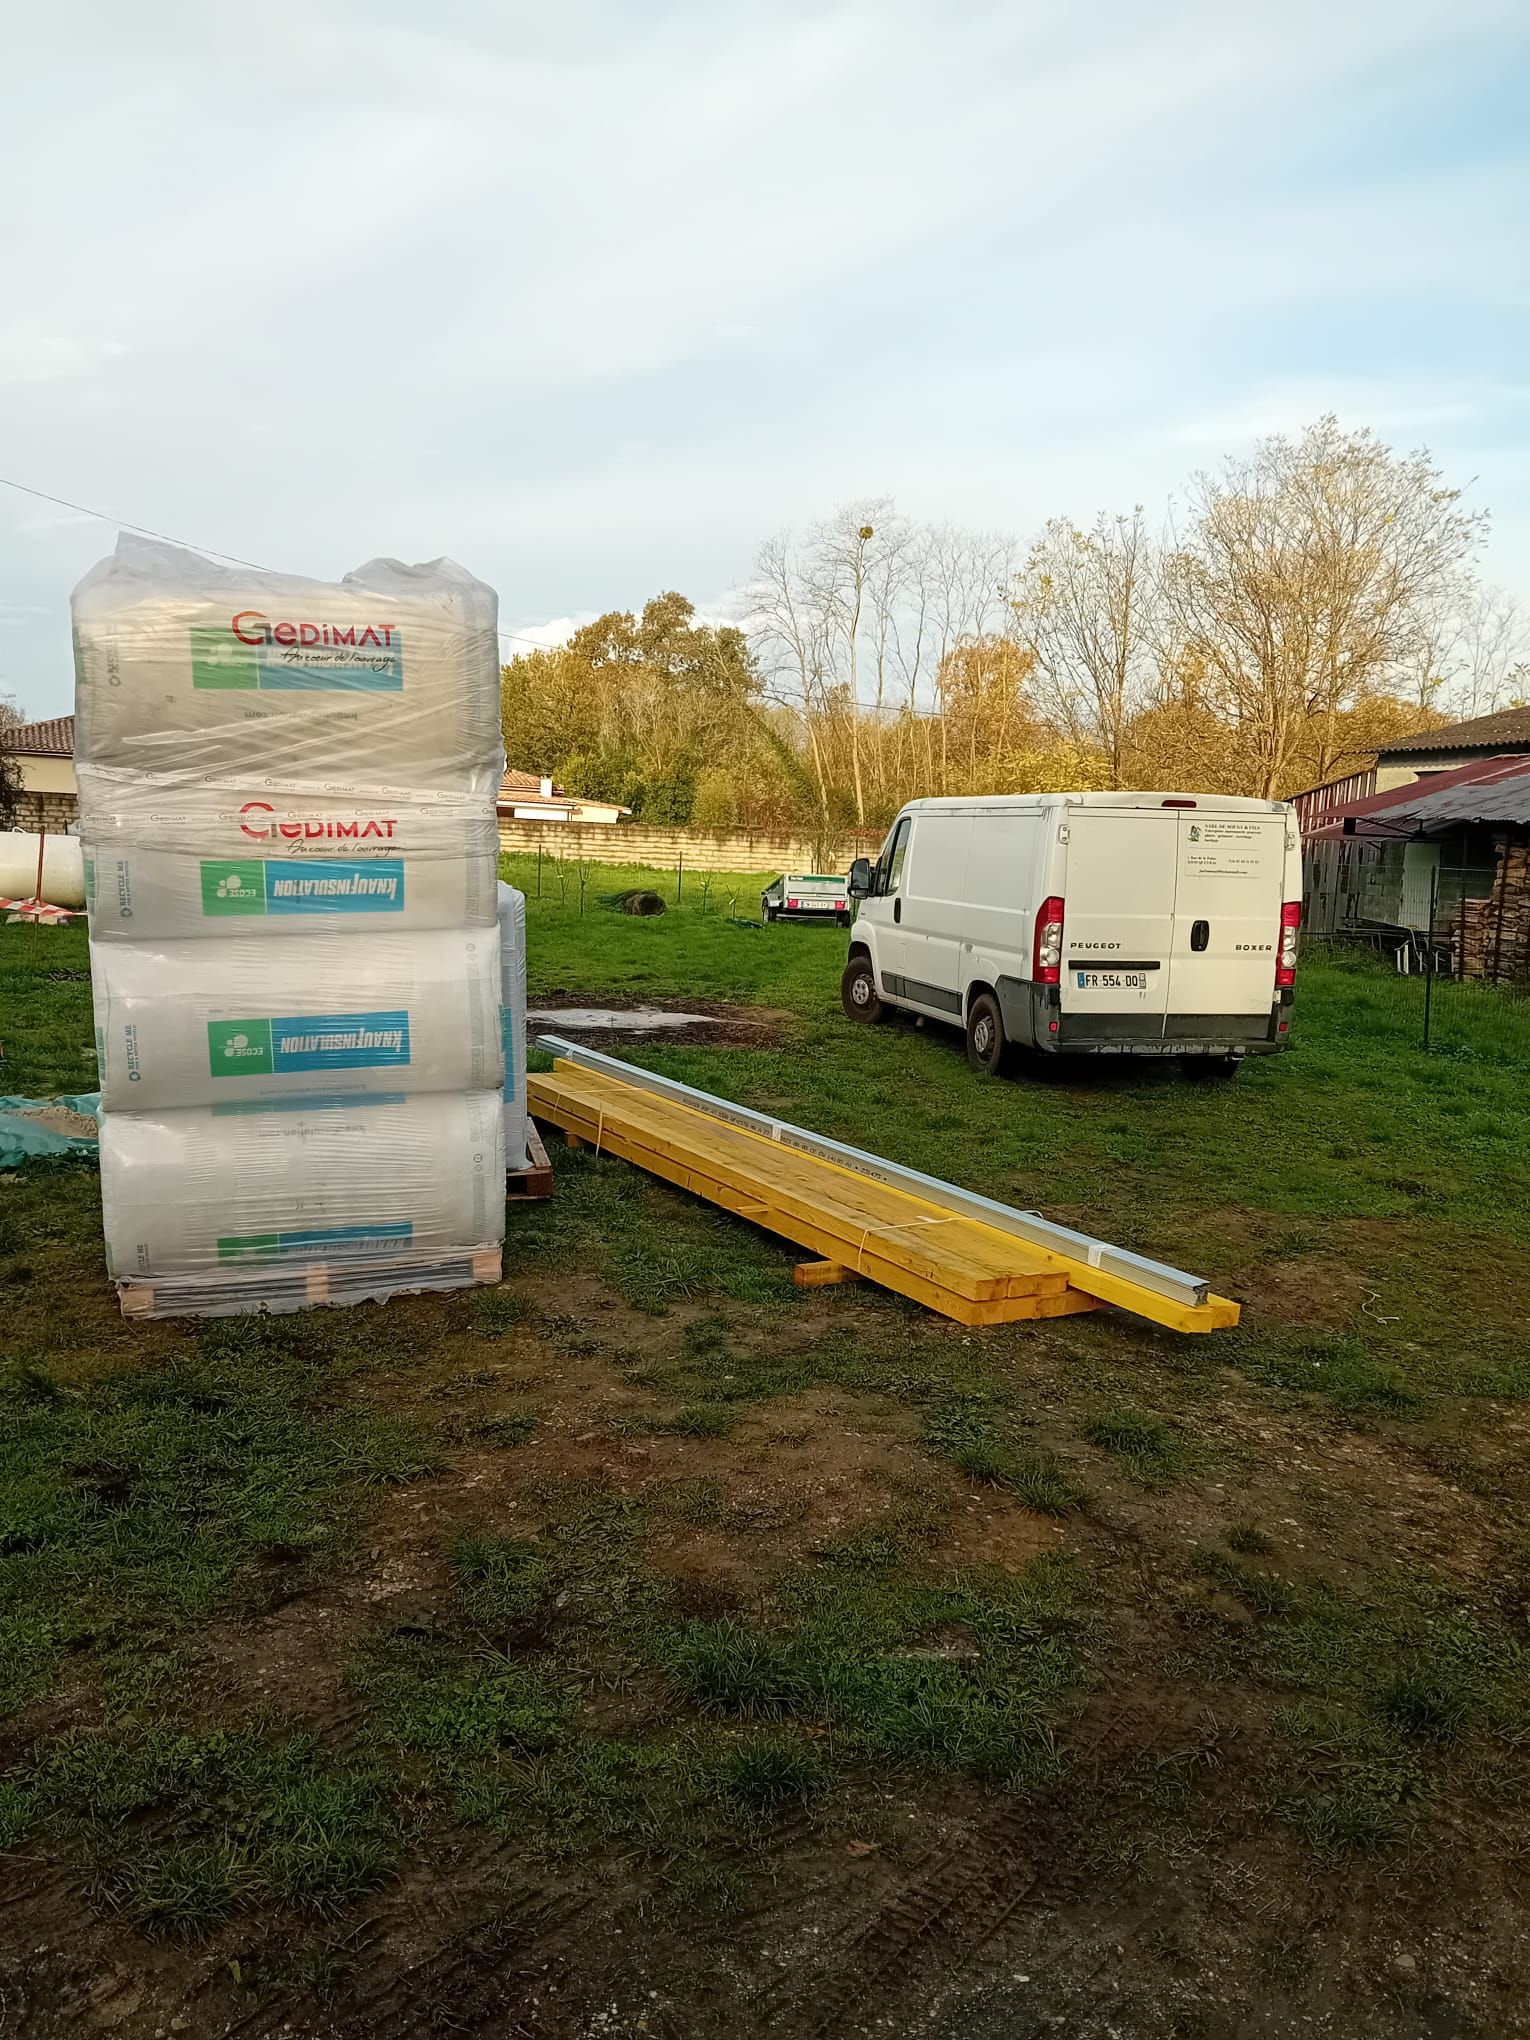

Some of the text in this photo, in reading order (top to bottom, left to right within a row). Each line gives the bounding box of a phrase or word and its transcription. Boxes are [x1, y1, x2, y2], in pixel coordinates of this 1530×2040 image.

[334, 651, 347, 662] de
[337, 843, 349, 852] de
[117, 861, 126, 905] RECYCLE ME
[228, 887, 257, 897] ECOSE
[125, 1025, 134, 1069] RECYCLE ME
[234, 1046, 263, 1057] ECOSE
